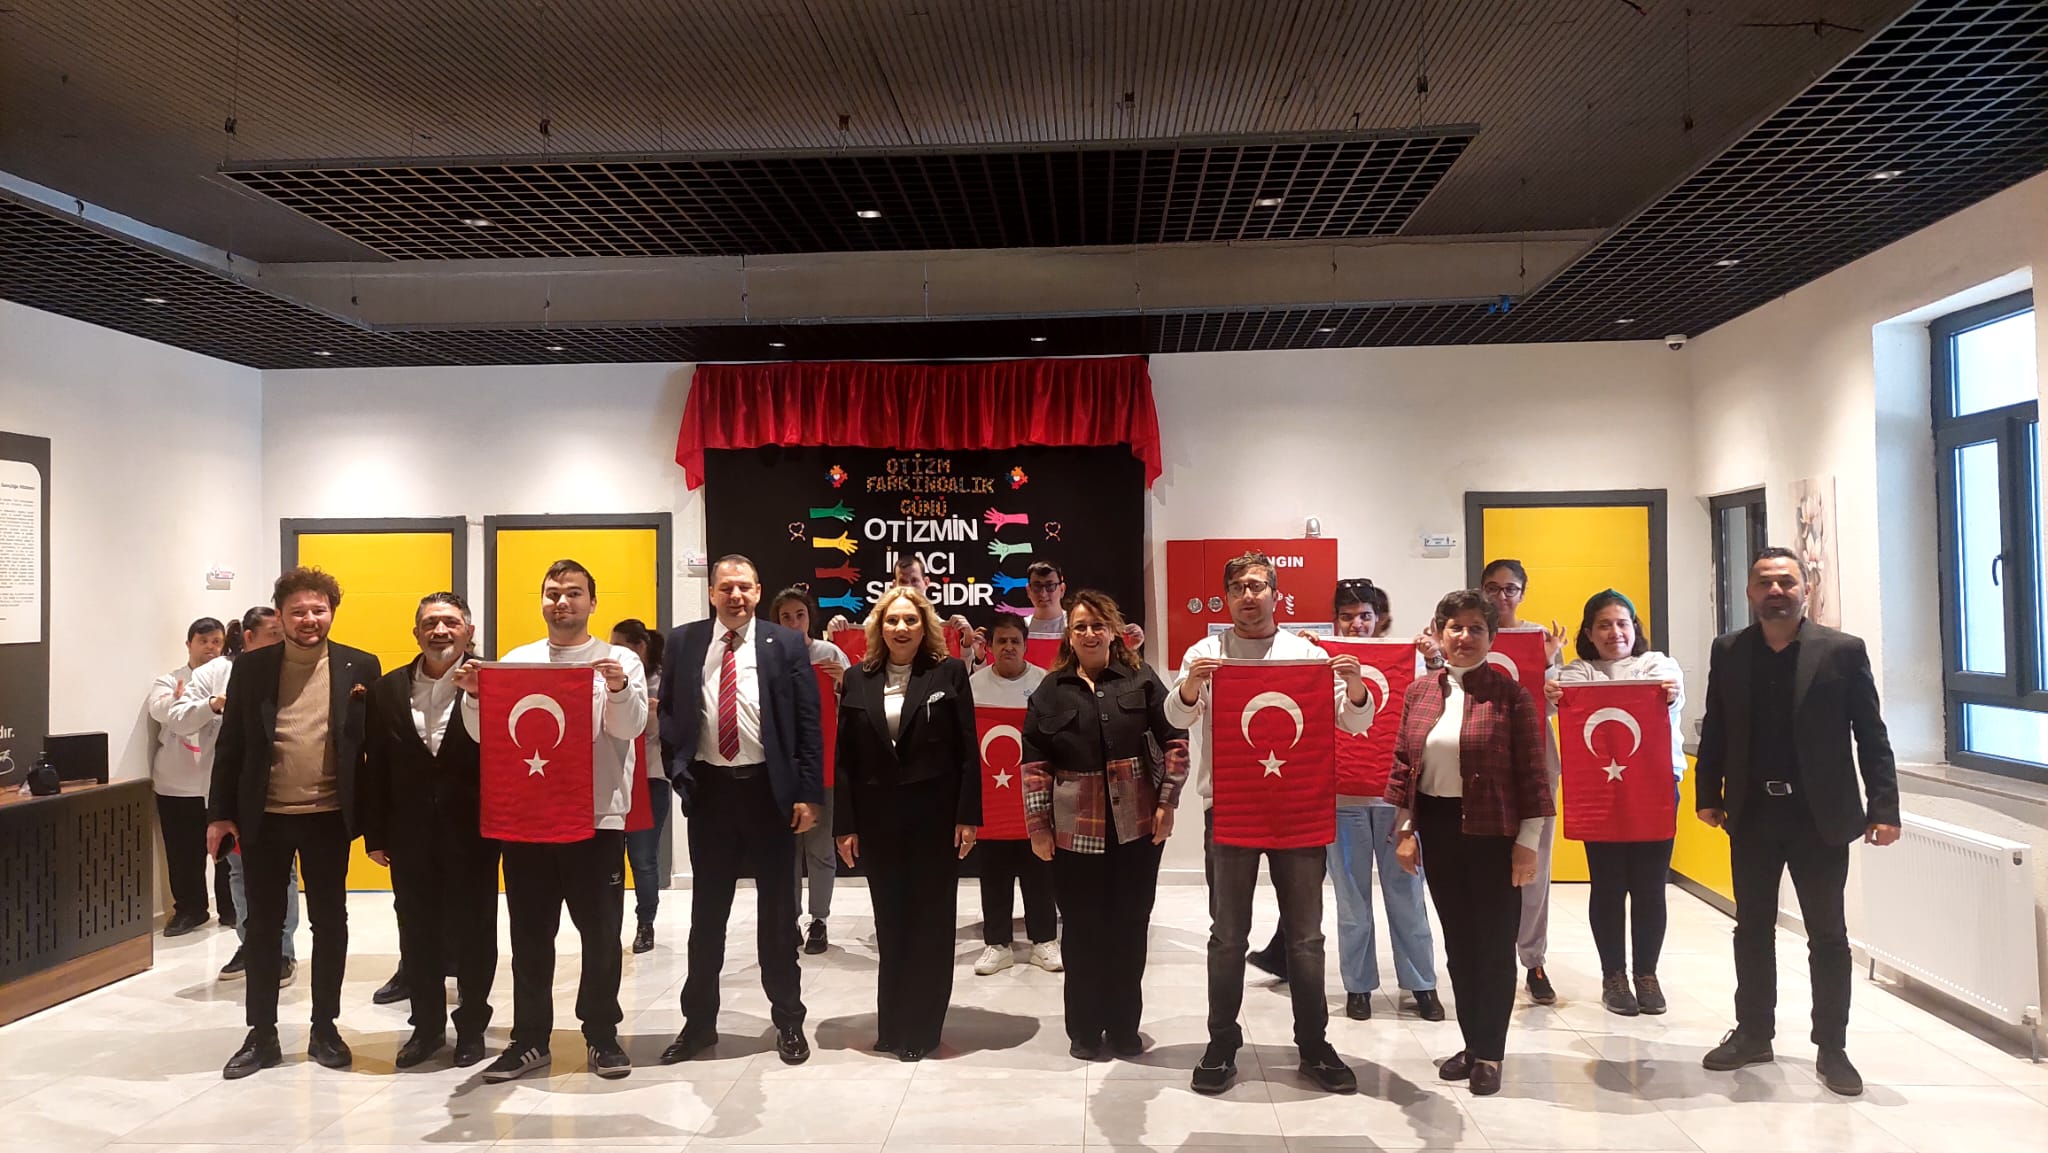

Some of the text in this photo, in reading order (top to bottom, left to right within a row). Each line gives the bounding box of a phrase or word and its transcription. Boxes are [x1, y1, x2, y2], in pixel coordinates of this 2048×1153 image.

[886, 453, 951, 475] OTİZM
[900, 495, 947, 516] GÜNÜ
[864, 514, 978, 542] OTİZMİN
[1266, 556, 1304, 568] NGIN
[866, 577, 994, 606] SGİDİR
